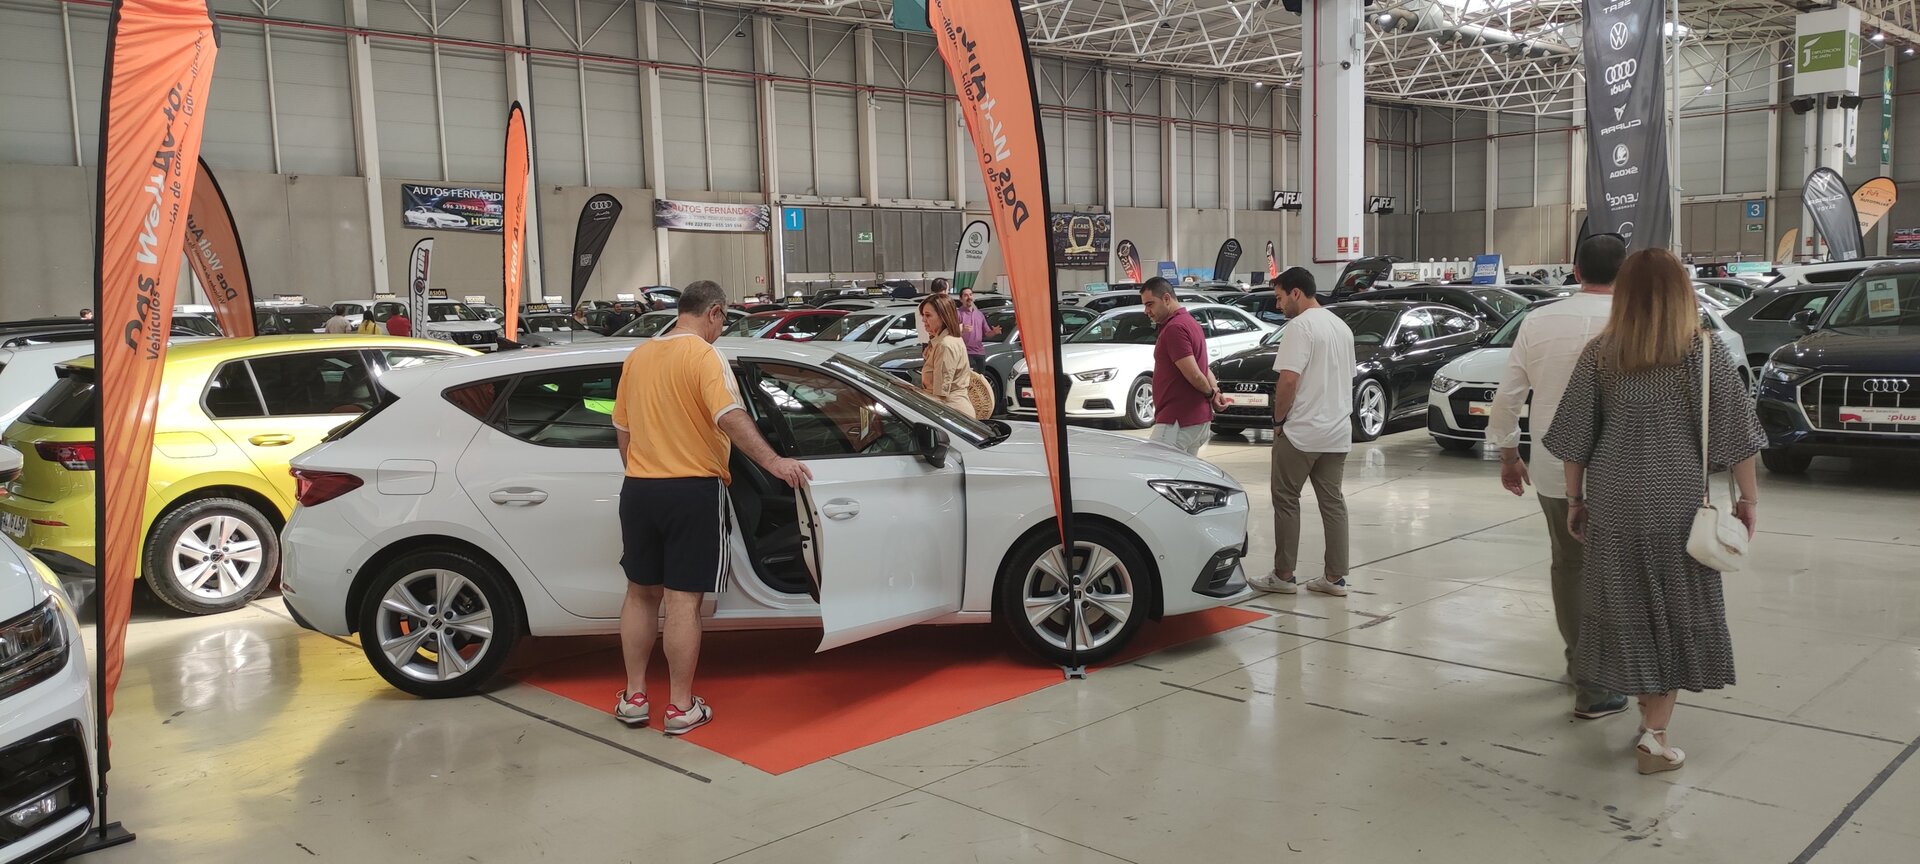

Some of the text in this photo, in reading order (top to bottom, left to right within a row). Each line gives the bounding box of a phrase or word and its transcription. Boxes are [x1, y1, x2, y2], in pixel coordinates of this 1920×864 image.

[413, 186, 449, 197] AUTOS
[671, 203, 702, 213] AUTOS
[1750, 204, 1760, 217] 3
[790, 211, 797, 227] 1
[125, 273, 154, 355] Das
